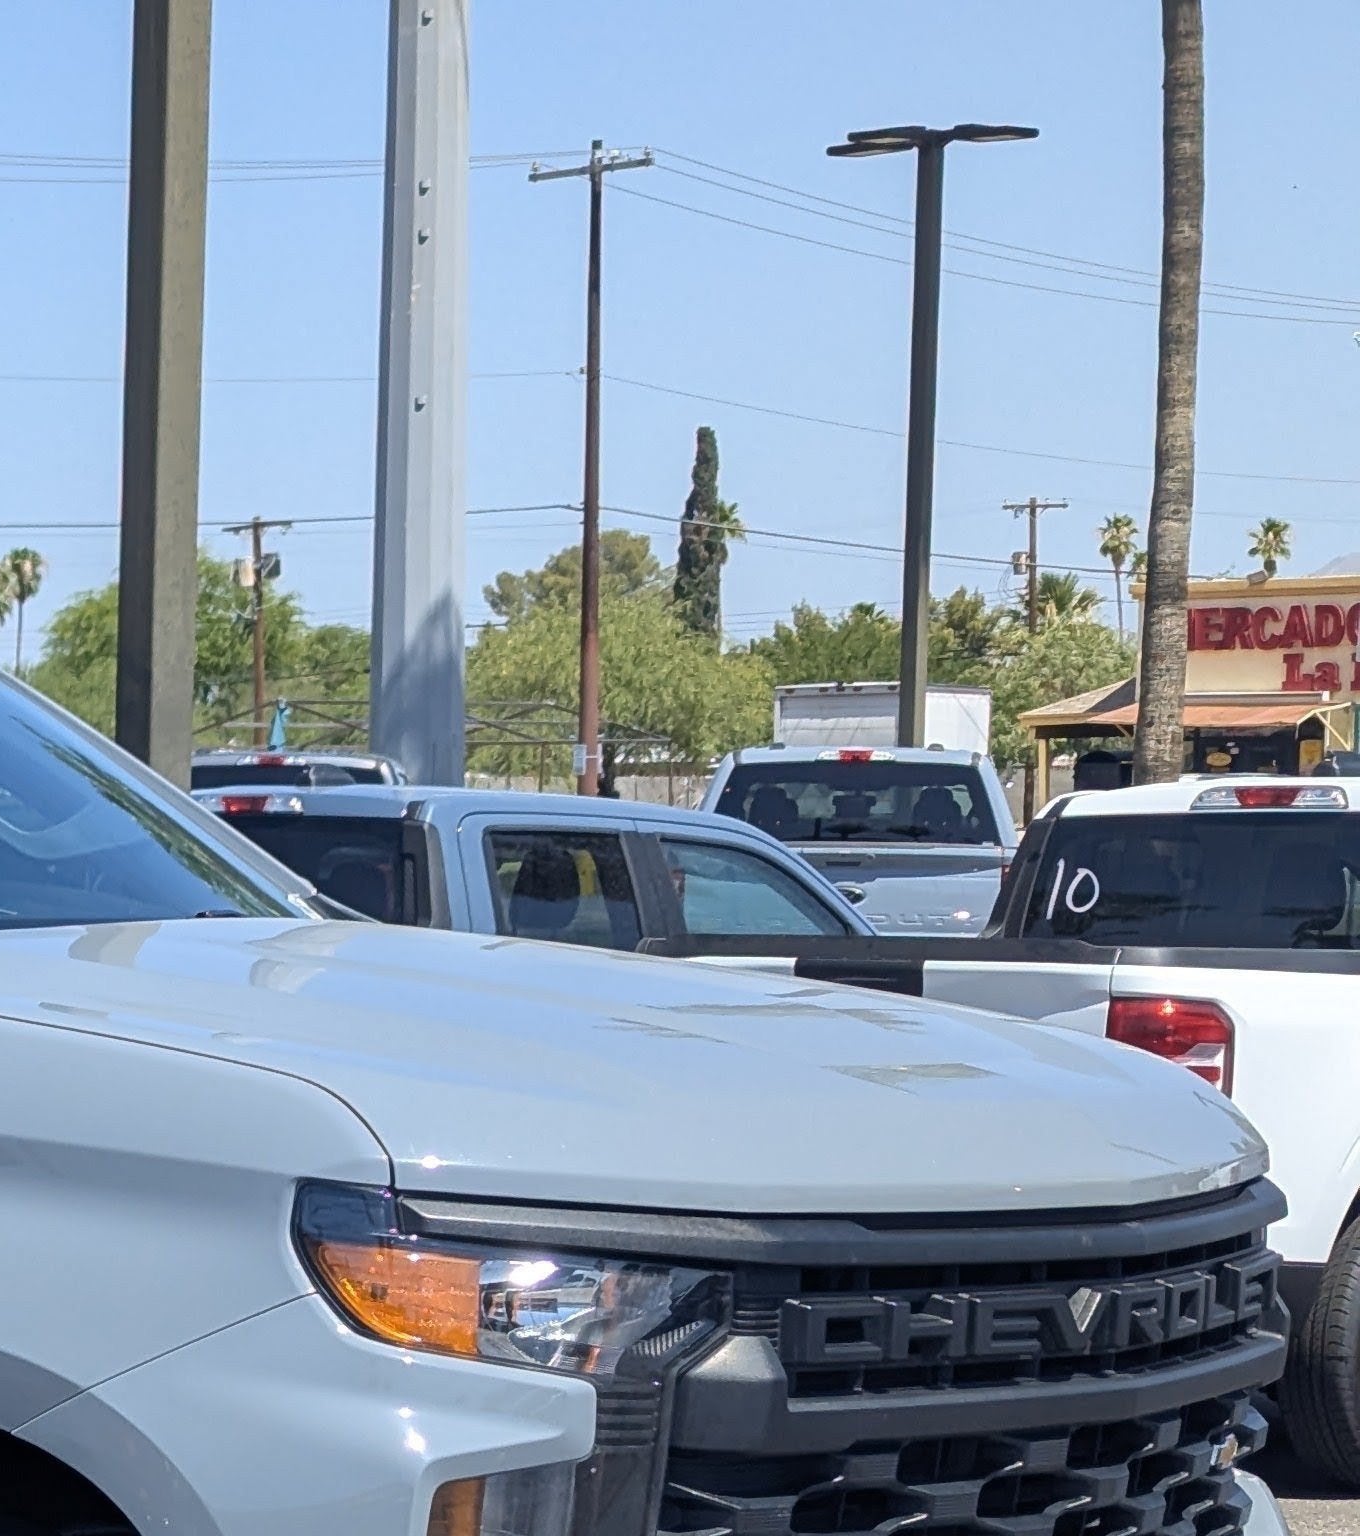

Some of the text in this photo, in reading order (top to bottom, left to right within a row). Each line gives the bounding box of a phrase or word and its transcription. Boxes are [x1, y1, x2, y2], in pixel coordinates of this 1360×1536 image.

[1187, 603, 1360, 651] ERCAD
[1281, 652, 1342, 691] La
[1045, 858, 1100, 920] 10
